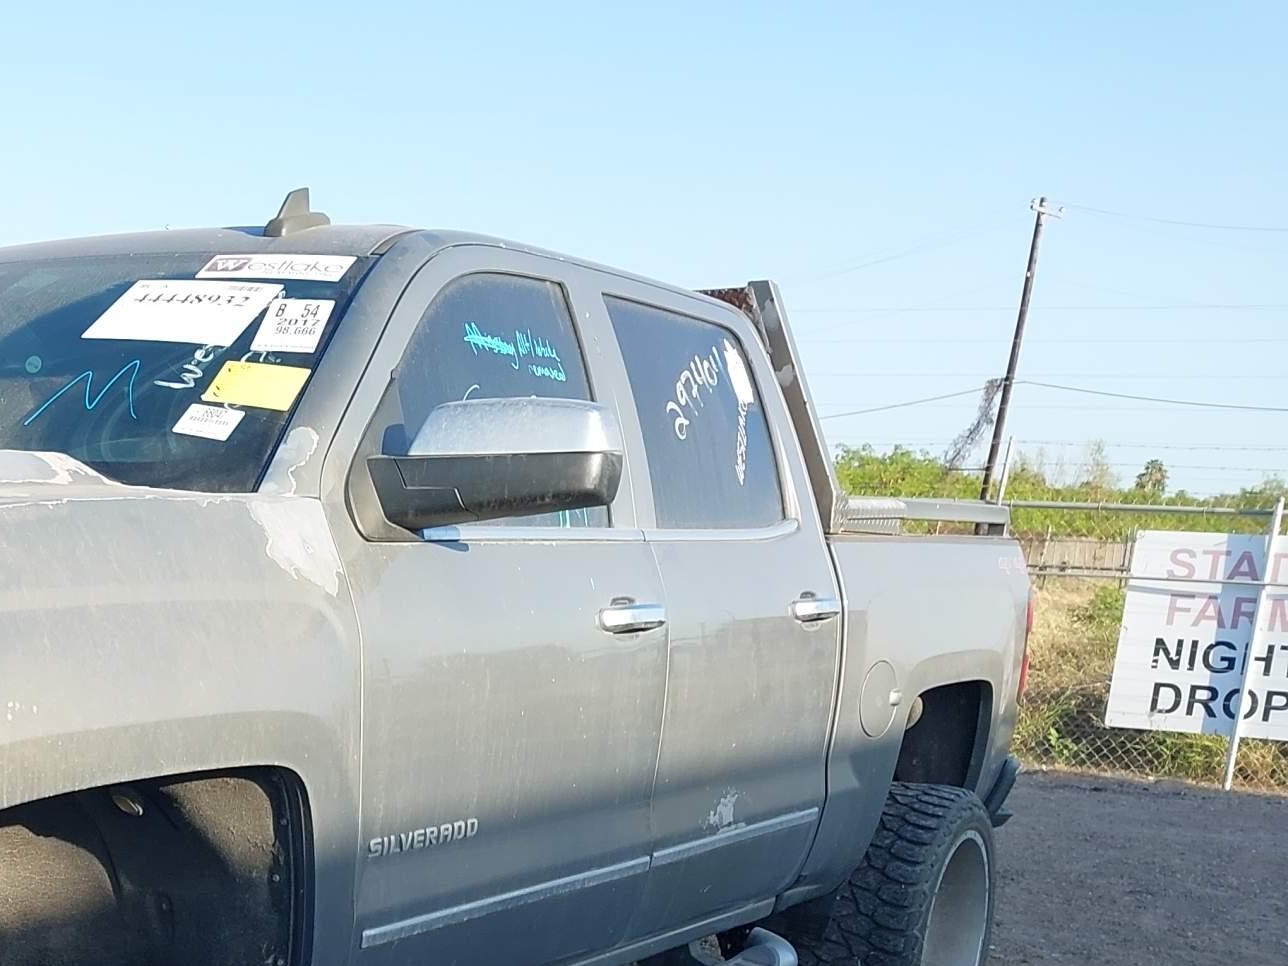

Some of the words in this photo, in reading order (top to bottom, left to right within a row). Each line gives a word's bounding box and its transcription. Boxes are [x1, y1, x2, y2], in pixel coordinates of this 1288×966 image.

[132, 292, 252, 307] 44448932
[275, 303, 287, 318] B
[300, 303, 320, 318] 54
[276, 318, 321, 327] 2017
[368, 817, 479, 858] SILVERADO
